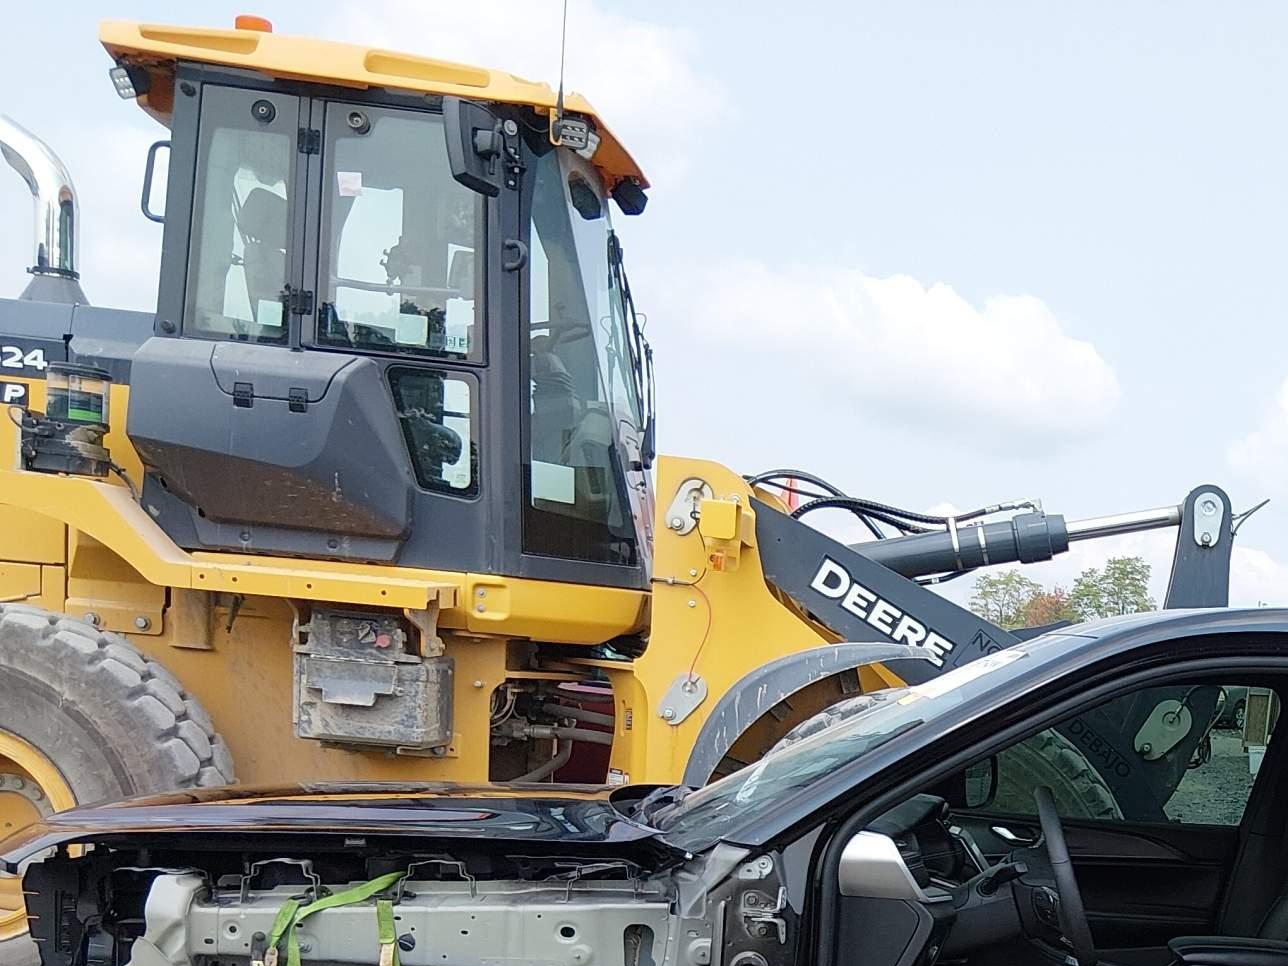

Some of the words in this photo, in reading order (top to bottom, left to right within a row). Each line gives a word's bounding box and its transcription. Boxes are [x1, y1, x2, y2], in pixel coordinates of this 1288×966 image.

[0, 346, 48, 370] 24
[4, 383, 26, 403] P
[810, 557, 954, 668] DEERE
[1068, 718, 1131, 777] DEBAJO
